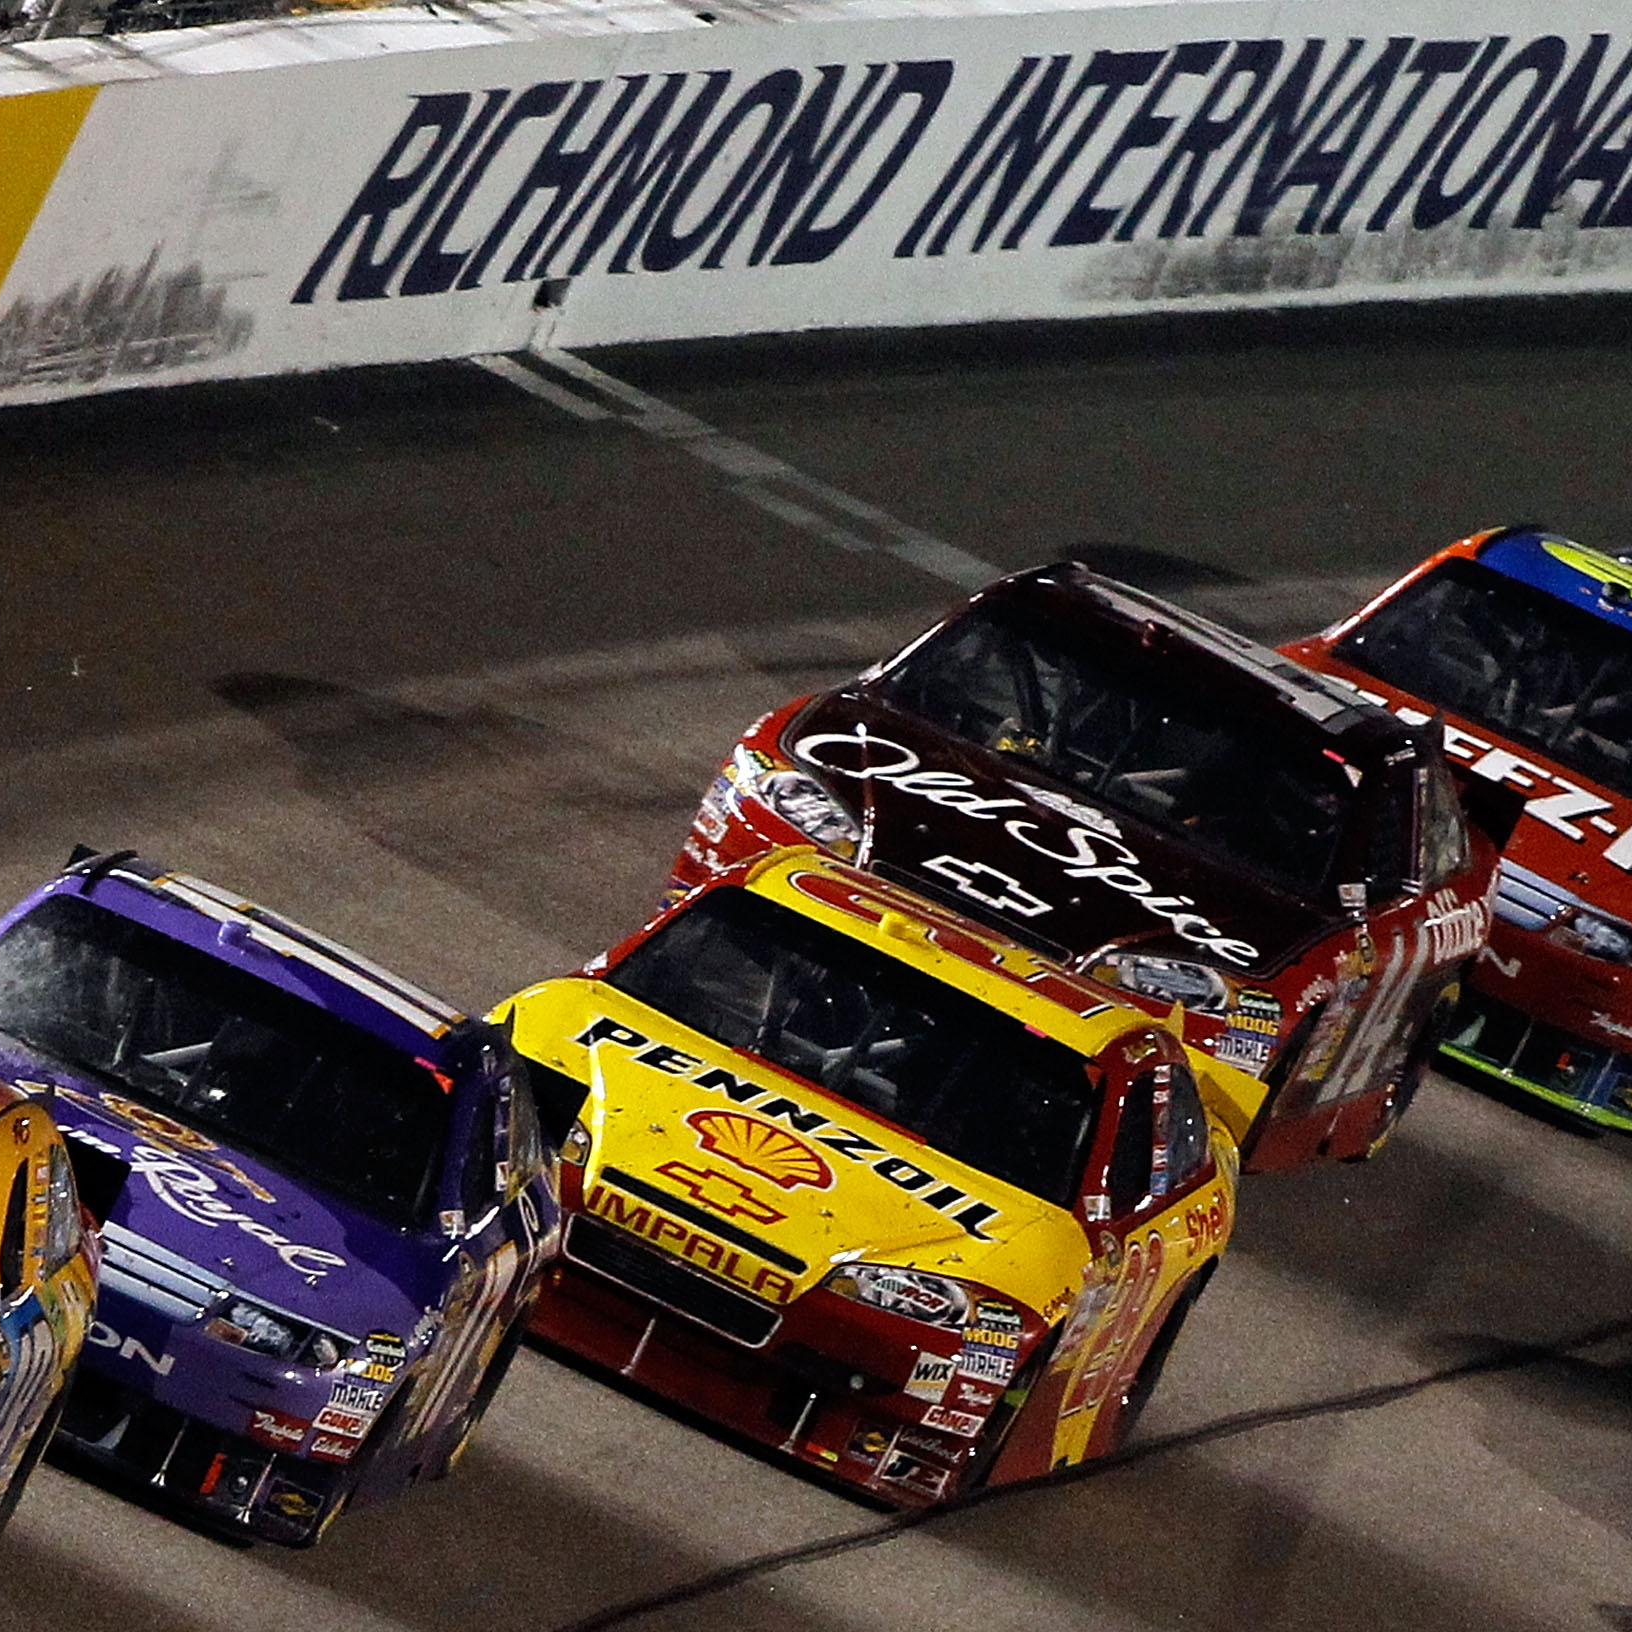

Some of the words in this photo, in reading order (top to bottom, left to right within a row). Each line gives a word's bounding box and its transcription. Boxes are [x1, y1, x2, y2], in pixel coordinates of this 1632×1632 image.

[295, 60, 952, 304] RICHMOND
[794, 733, 1028, 819] Old
[1004, 819, 1260, 969] Spice
[1226, 1012, 1279, 1036] MOOG
[573, 1015, 1006, 1243] PENNZOIL
[129, 1145, 347, 1277] Royal
[586, 1185, 795, 1306] IMPALA
[914, 1362, 953, 1381] WIX
[961, 1352, 1016, 1380] MAHLE
[962, 1327, 1019, 1349] MOOG
